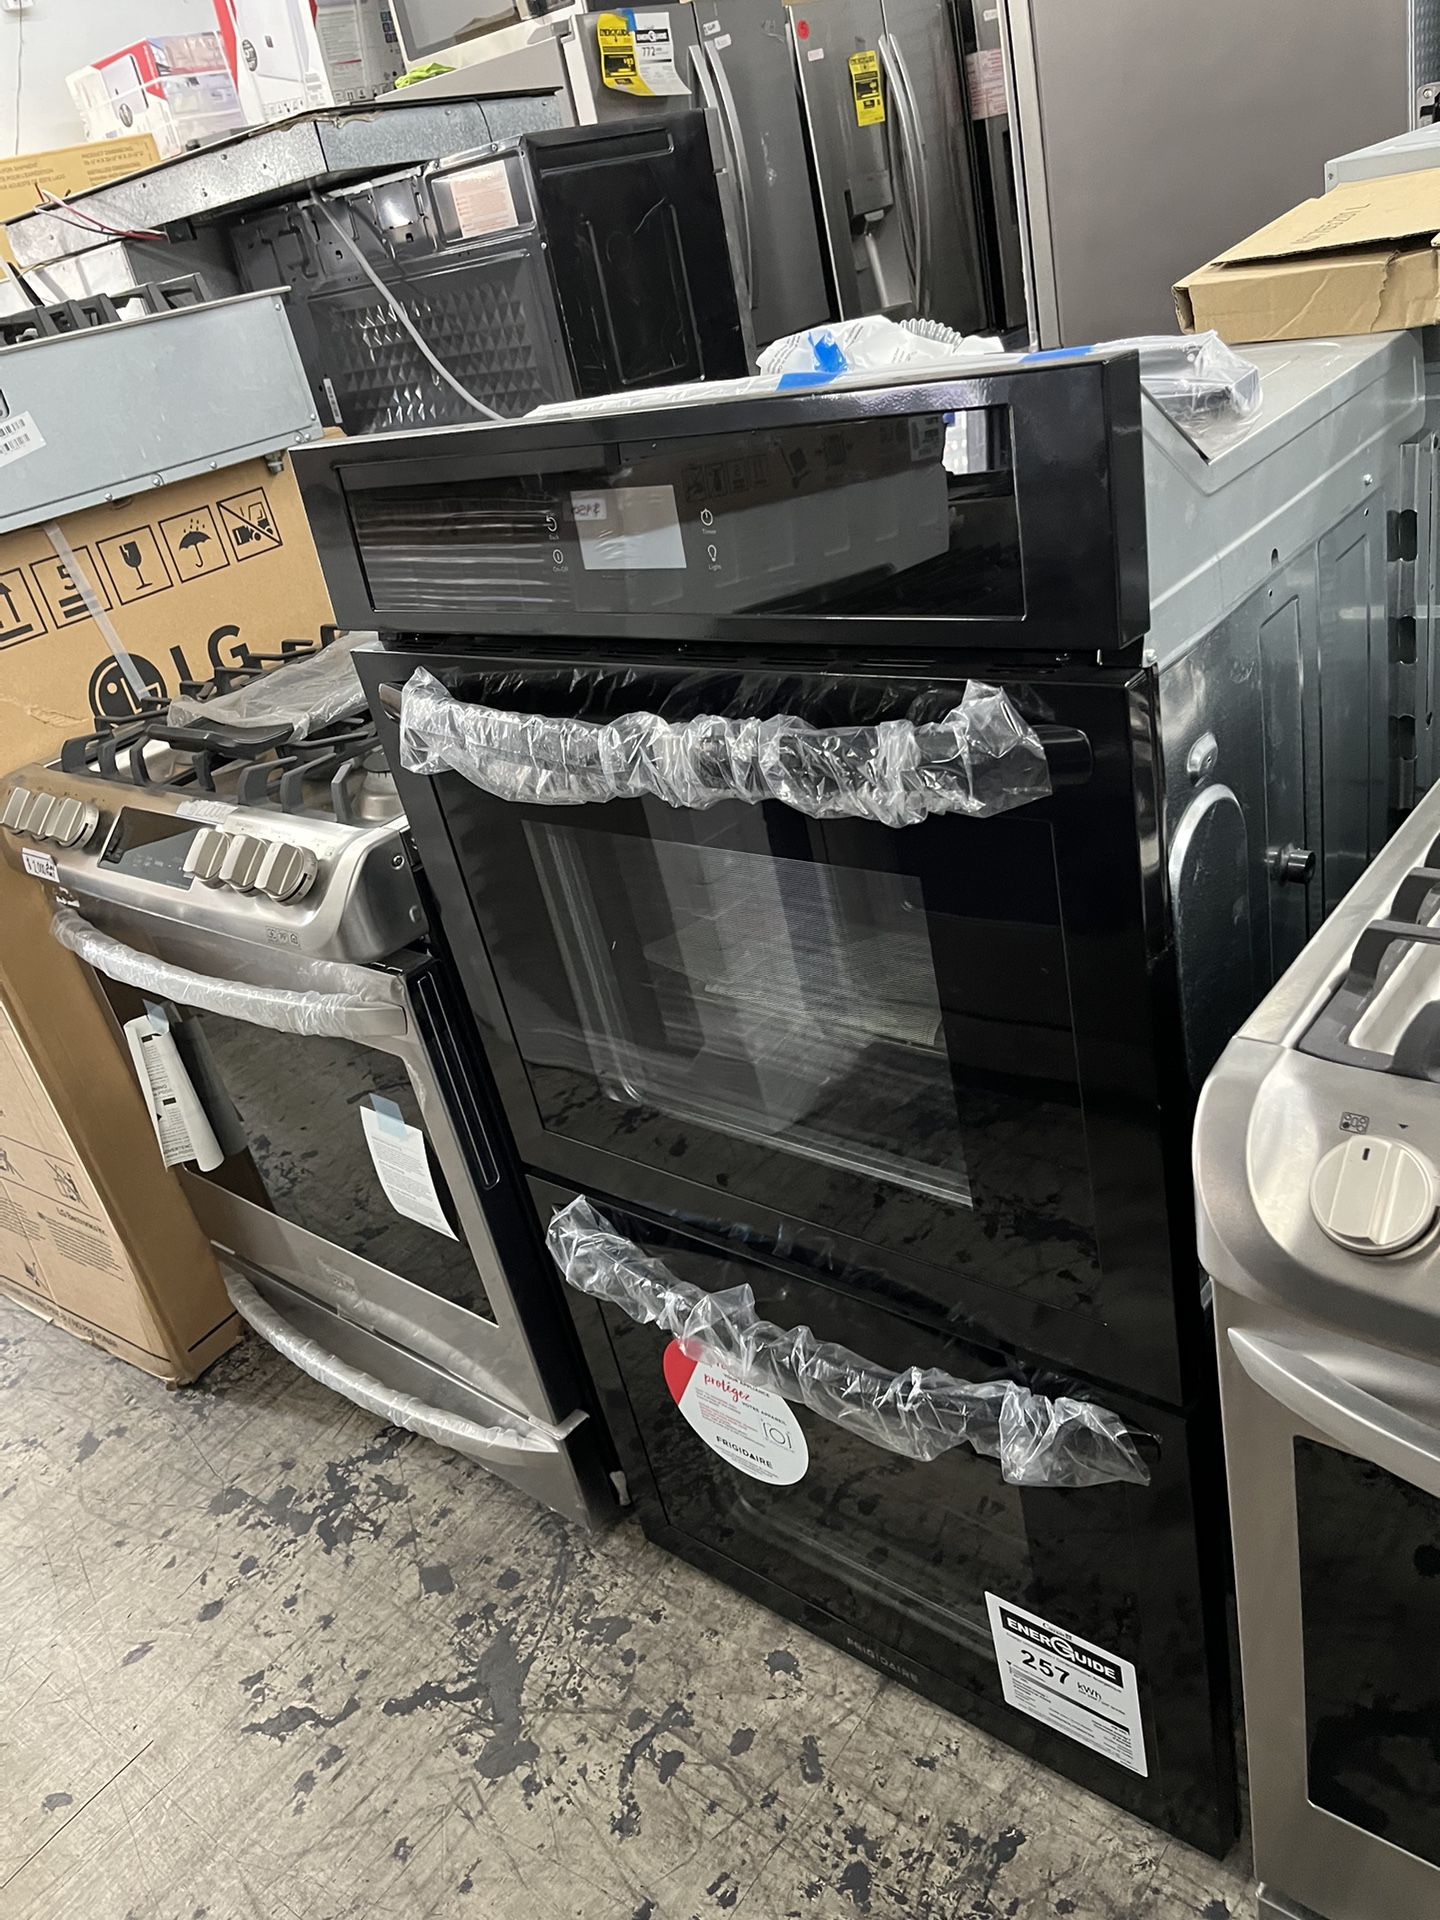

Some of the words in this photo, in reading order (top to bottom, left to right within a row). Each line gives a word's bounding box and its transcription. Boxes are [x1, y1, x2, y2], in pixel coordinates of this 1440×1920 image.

[642, 47, 656, 56] 772
[169, 624, 251, 683] LG
[704, 1373, 751, 1403] protégez
[716, 1435, 774, 1469] FRIGIDAIRE
[1006, 1616, 1117, 1681] ENERGUIDE
[1020, 1649, 1071, 1685] 257
[1076, 1681, 1103, 1702] kWh
